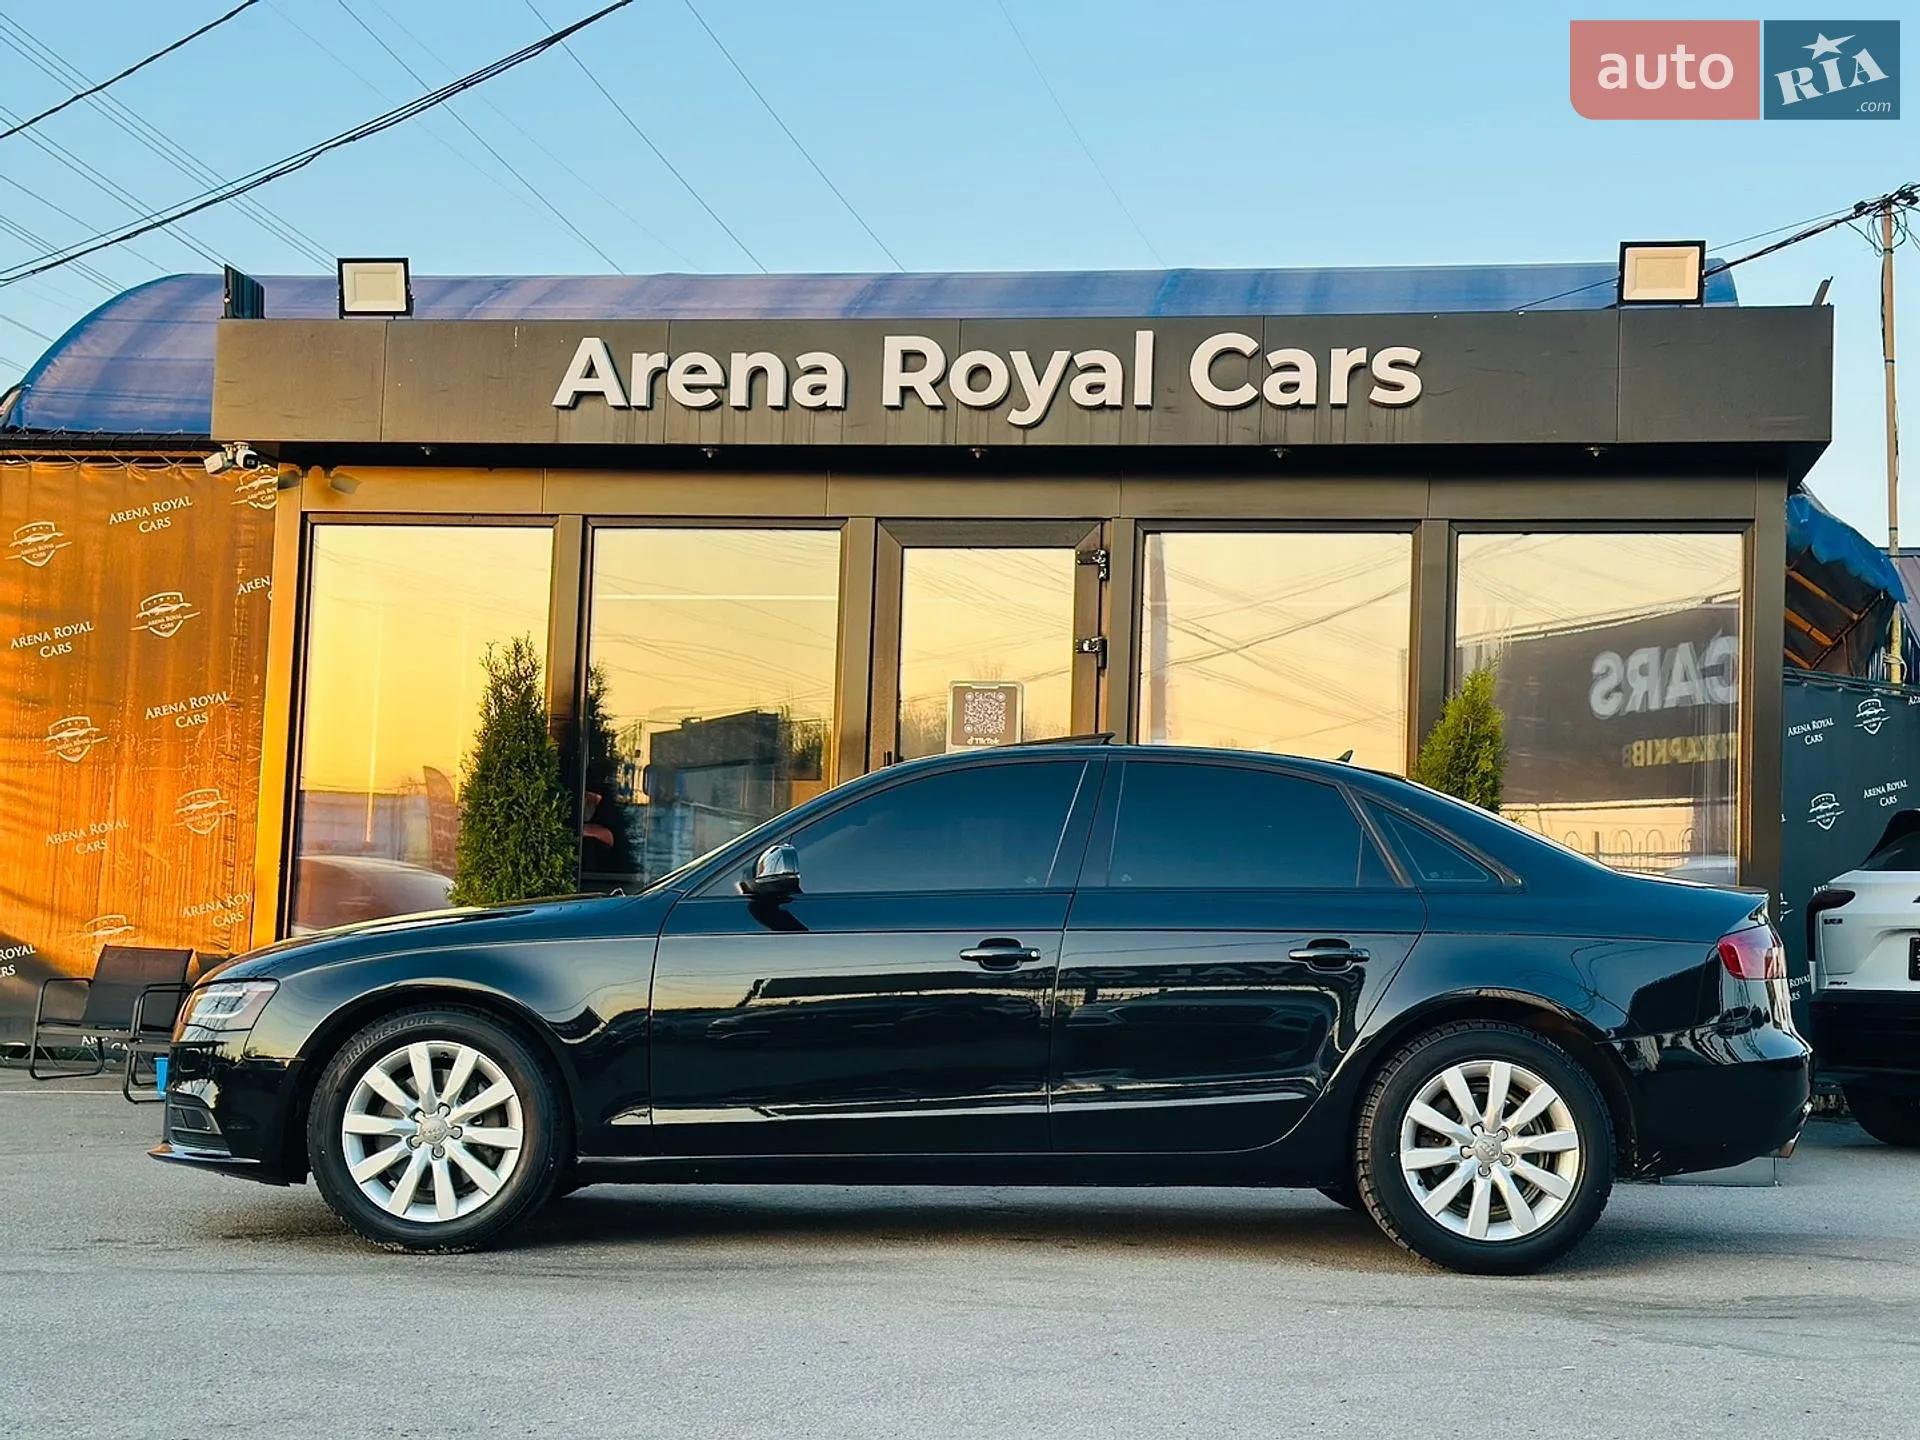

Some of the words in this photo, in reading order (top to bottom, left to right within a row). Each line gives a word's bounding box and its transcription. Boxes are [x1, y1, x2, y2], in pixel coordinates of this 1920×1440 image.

[552, 337, 846, 409] Arena
[882, 330, 1155, 428] Royal
[1190, 332, 1423, 409] Cars
[109, 506, 151, 526] ARENA
[152, 495, 194, 514] ROYAL
[138, 516, 172, 533] CARS
[237, 575, 271, 596] AREN
[10, 631, 51, 650] ARENA
[53, 621, 95, 639] ROYAL
[40, 641, 73, 658] CARS
[145, 702, 187, 720] ARENA
[189, 691, 231, 709] ROYAL
[175, 711, 209, 728] CARS
[1787, 723, 1812, 737] ARENA
[1811, 717, 1835, 731] ROYAL
[1804, 733, 1824, 746] CARS
[1863, 785, 1887, 799] ARENA
[1886, 779, 1909, 793] ROYAL
[1879, 795, 1898, 807] CARS
[45, 827, 87, 847] ARENA
[89, 816, 129, 836] ROYAL
[76, 839, 107, 855] CARS
[183, 901, 224, 918] ARENA
[225, 892, 253, 908] ROY
[212, 910, 246, 928] CARS
